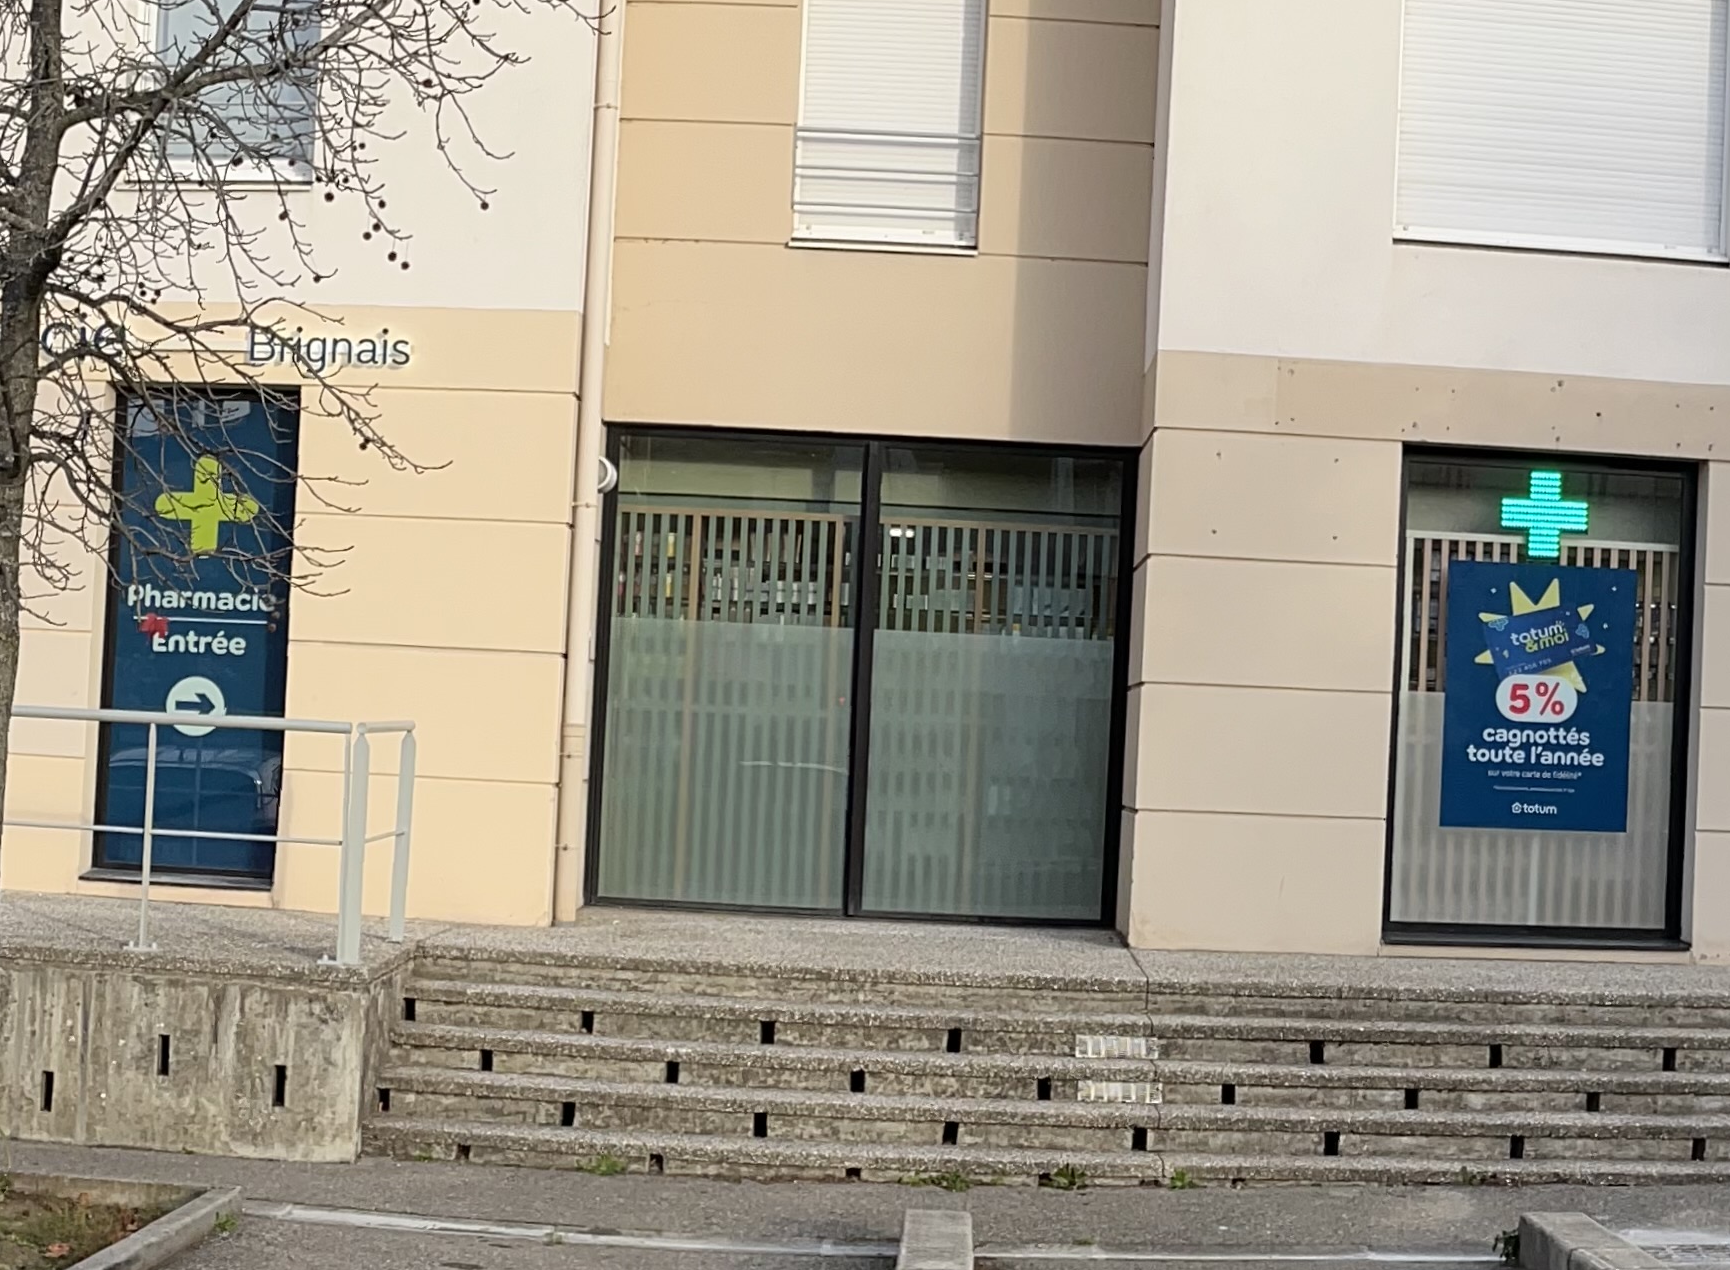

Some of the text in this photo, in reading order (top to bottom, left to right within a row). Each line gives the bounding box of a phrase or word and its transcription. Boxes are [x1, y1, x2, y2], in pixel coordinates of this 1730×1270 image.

[247, 326, 411, 374] Brignais
[152, 630, 247, 656] Entrée
[1510, 624, 1564, 646] totum
[1508, 681, 1565, 716] 5%
[1482, 727, 1591, 748] cagnottés
[1466, 744, 1605, 767] toute l'année
[1522, 803, 1558, 814] totum
